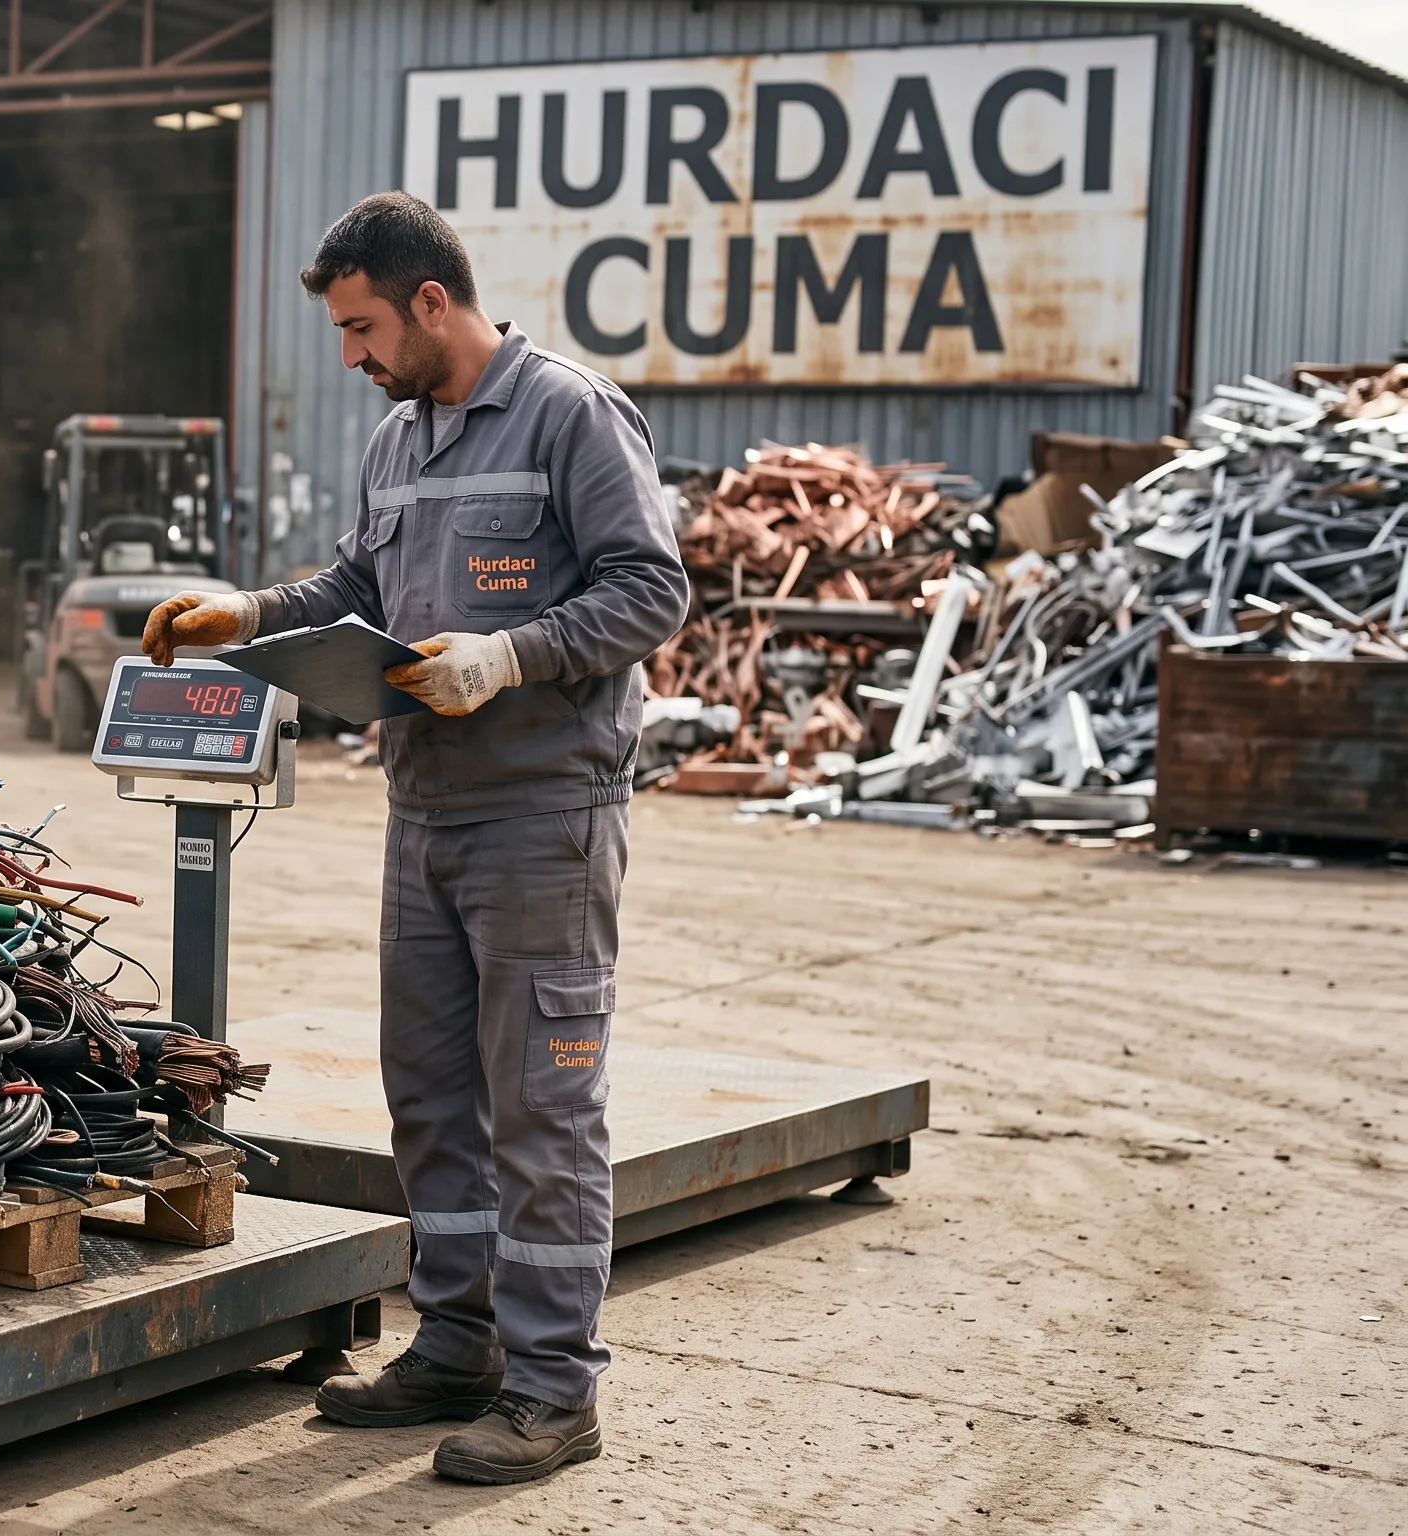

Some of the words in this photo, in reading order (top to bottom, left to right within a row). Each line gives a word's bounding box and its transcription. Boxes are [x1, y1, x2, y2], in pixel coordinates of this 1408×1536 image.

[435, 66, 1117, 210] HURDACI
[564, 230, 1005, 357] CUMA
[468, 555, 536, 573] Hurdacı
[476, 575, 528, 591] Cuma
[185, 686, 241, 715] 480
[555, 1053, 595, 1068] Cuma
